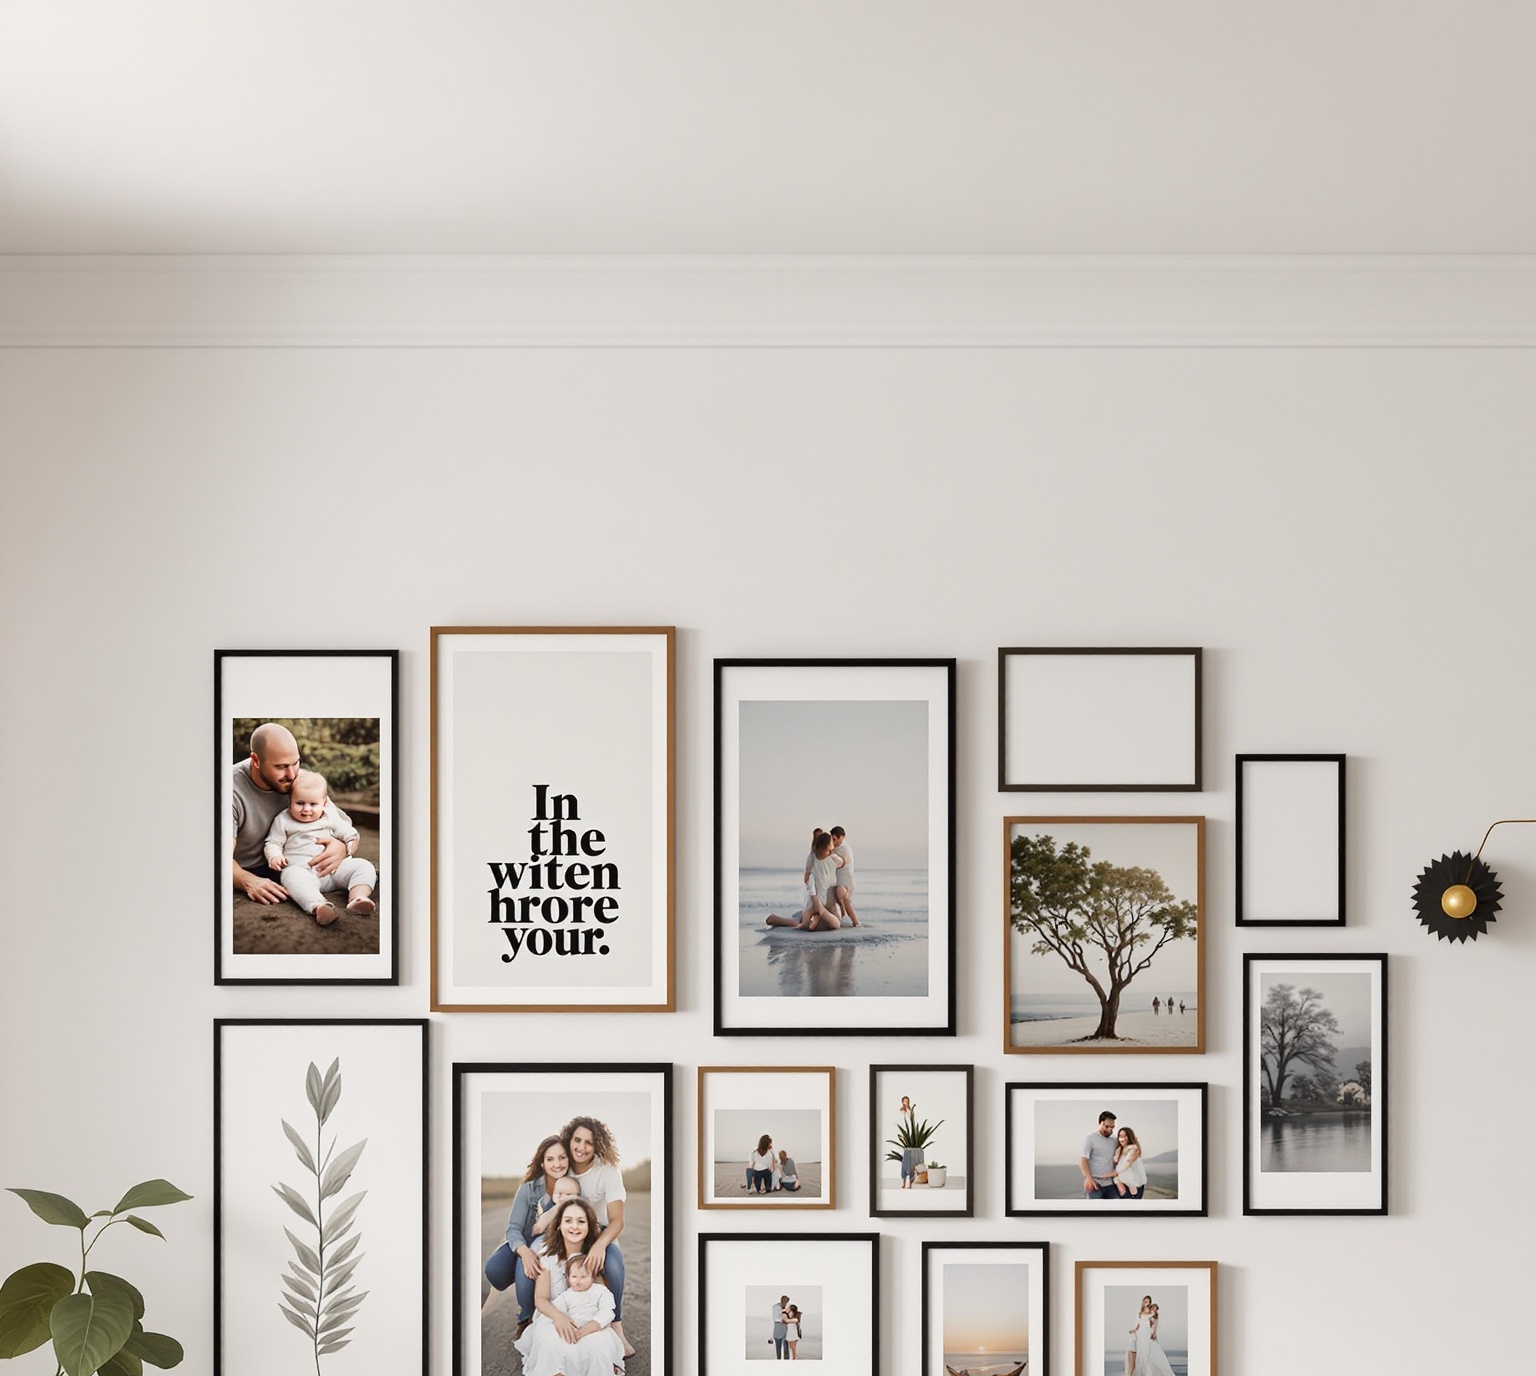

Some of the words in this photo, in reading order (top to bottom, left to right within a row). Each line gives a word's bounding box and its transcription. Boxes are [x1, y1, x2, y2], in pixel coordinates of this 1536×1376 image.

[530, 784, 581, 820] In
[527, 819, 607, 857] the
[487, 855, 622, 890] witen
[487, 888, 620, 924] hrore
[501, 927, 610, 964] your.
